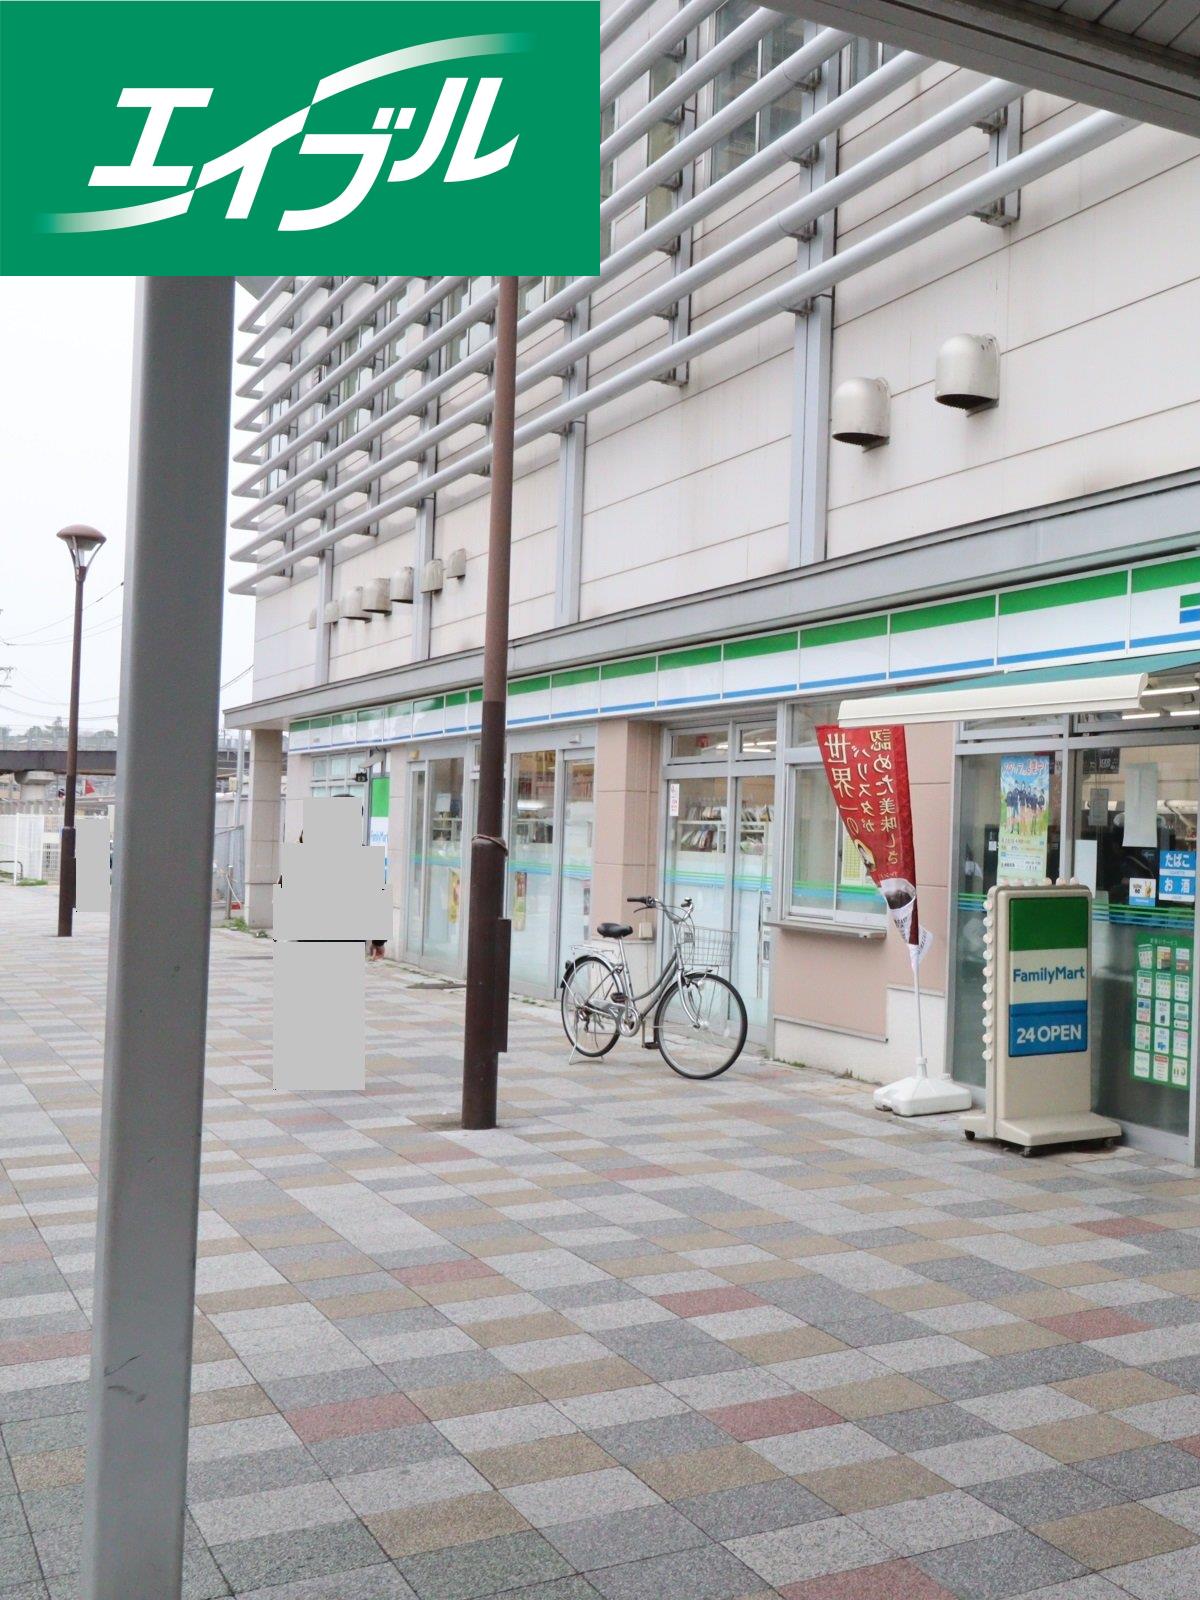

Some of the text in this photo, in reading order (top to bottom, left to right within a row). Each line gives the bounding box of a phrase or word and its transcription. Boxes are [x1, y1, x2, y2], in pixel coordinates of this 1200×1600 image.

[1164, 852, 1191, 868] たばこ
[1013, 966, 1085, 984] FamilyMart
